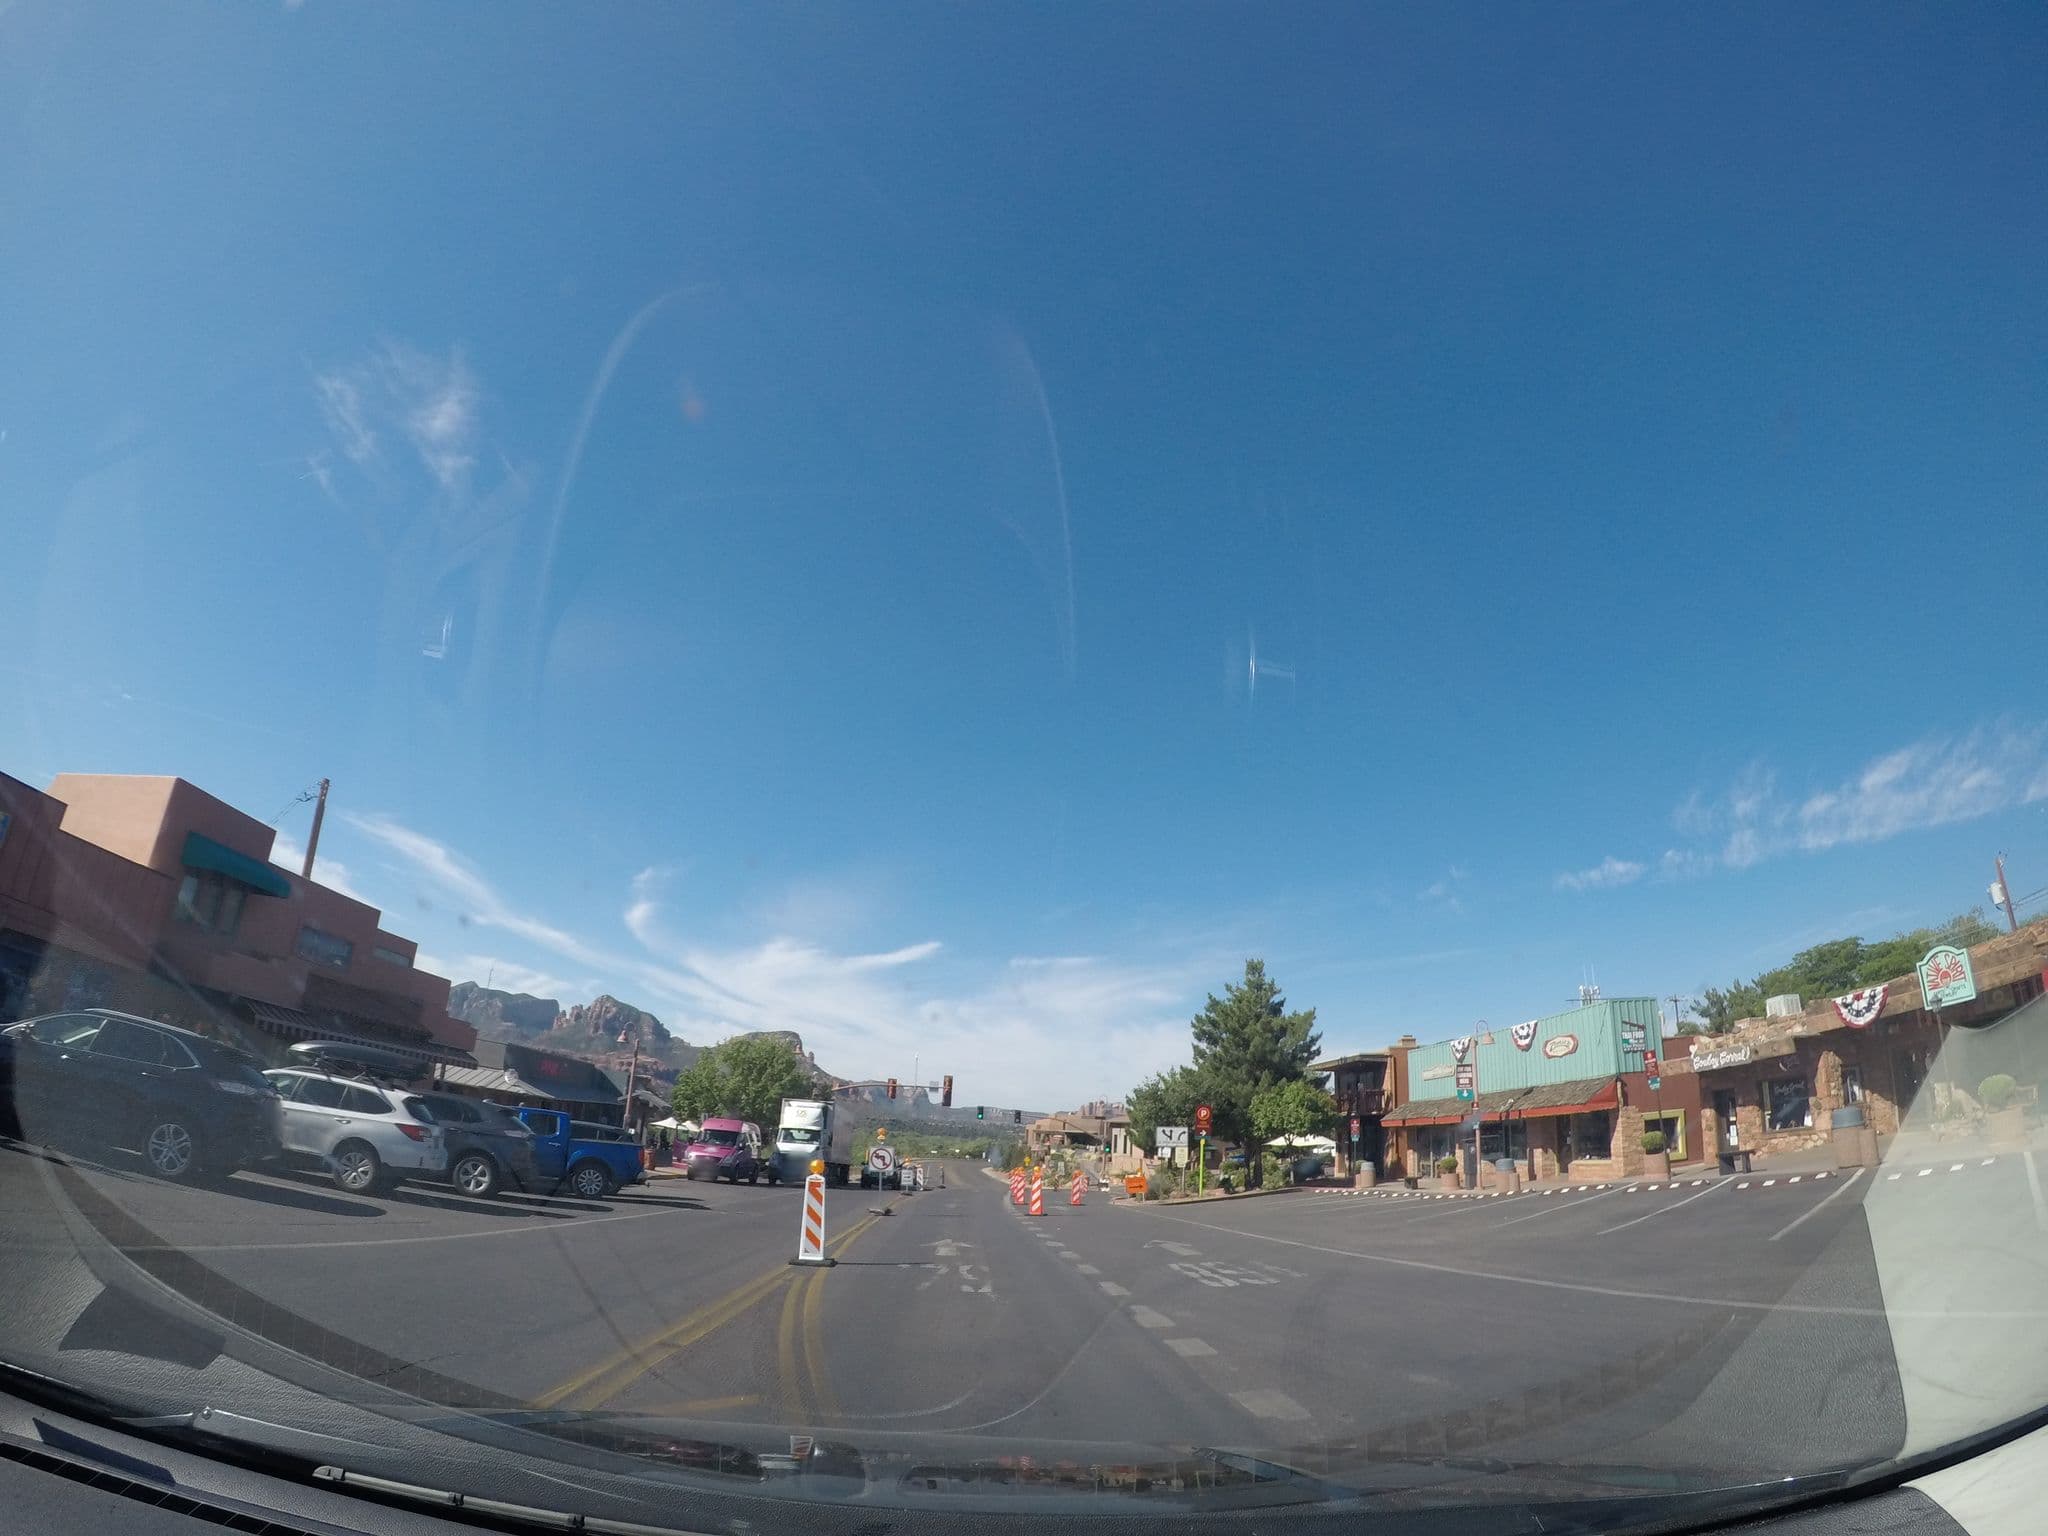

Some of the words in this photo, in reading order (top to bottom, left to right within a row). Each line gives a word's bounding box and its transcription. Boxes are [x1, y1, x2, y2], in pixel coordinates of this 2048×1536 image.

[1693, 1053, 1719, 1070] Cowboy
[1719, 1049, 1746, 1066] Corral
[1200, 1109, 1207, 1118] P
